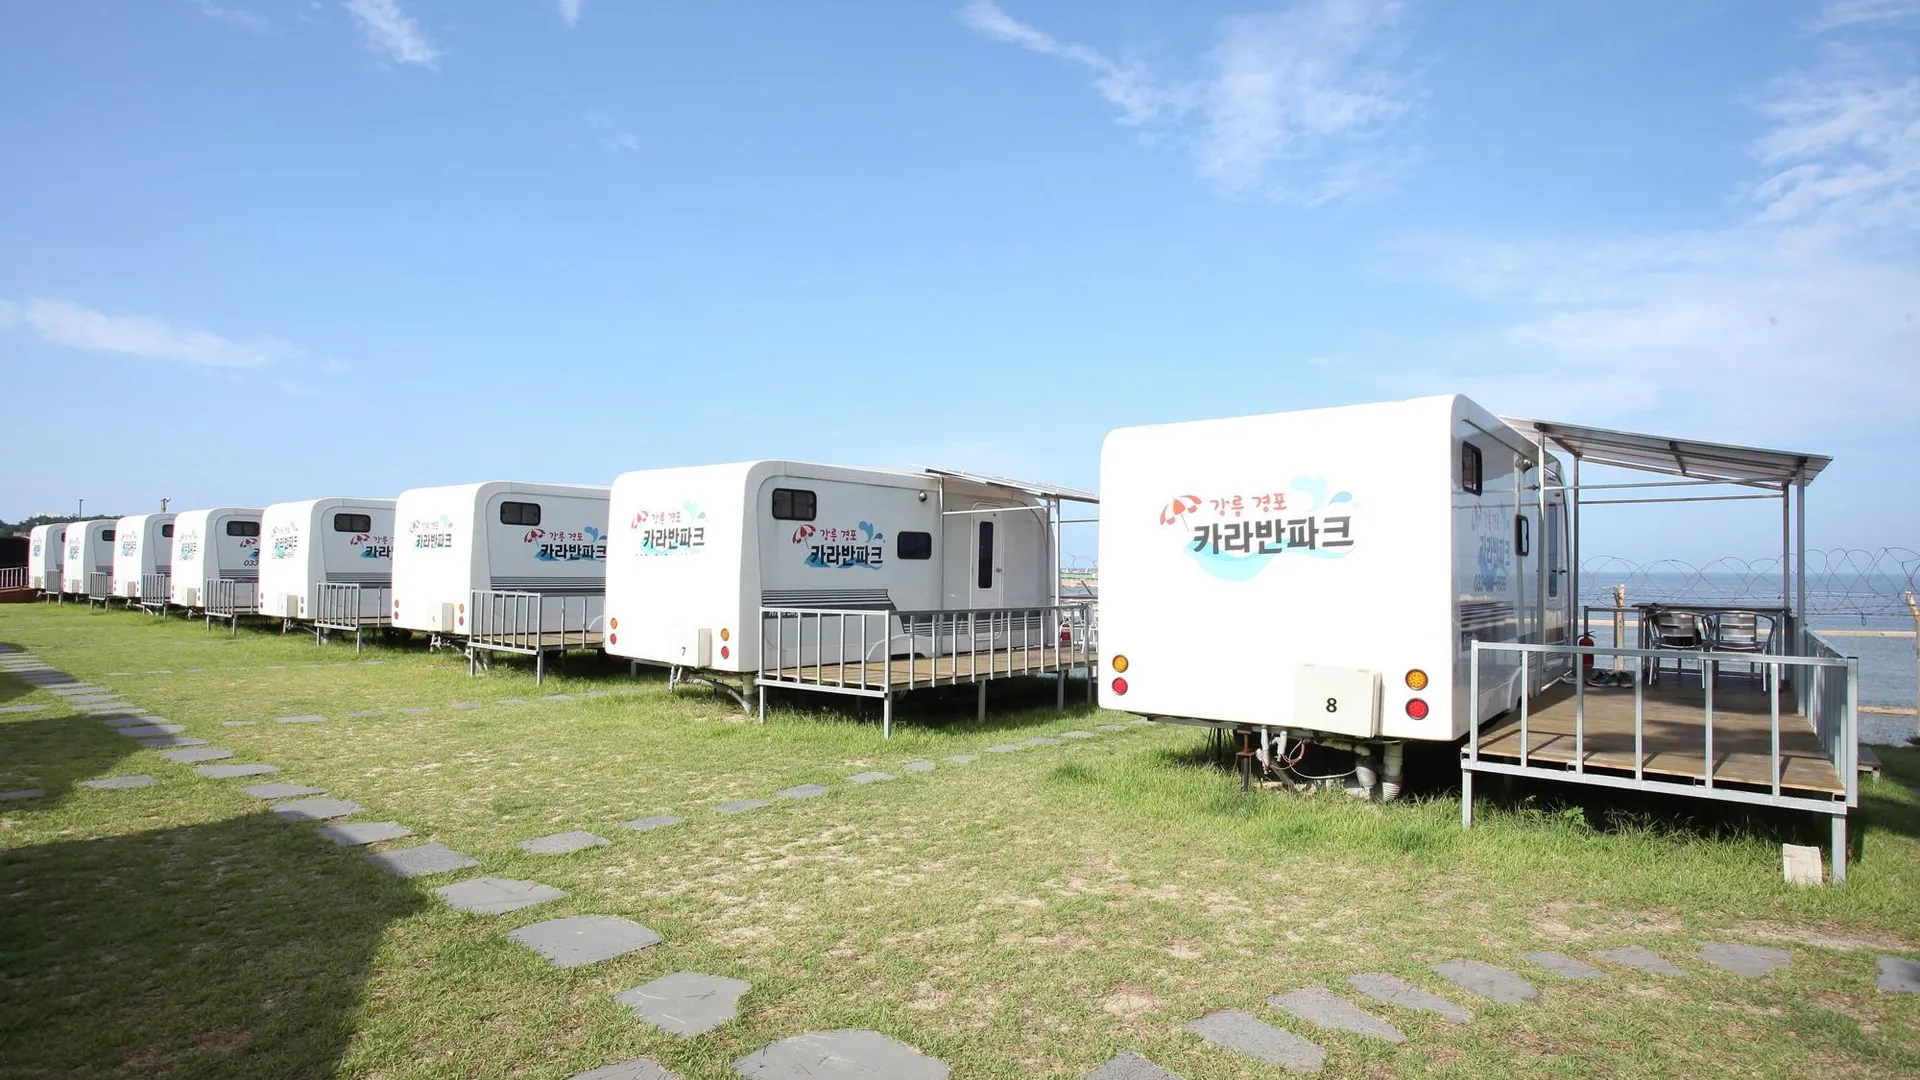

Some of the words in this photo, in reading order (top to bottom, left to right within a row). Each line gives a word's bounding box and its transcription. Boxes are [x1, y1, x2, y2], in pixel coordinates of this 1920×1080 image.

[1209, 495, 1245, 517] 강릉
[1251, 492, 1288, 513] 경포
[643, 526, 705, 550] 카라반파크
[820, 528, 837, 542] 강릉
[840, 529, 857, 541] 경포
[1193, 515, 1354, 555] 카라반파크
[365, 546, 393, 560] 카라
[541, 543, 607, 560] 카라반파크
[810, 544, 883, 566] 카라반파크
[681, 646, 687, 656] 7
[1326, 697, 1338, 713] 8
